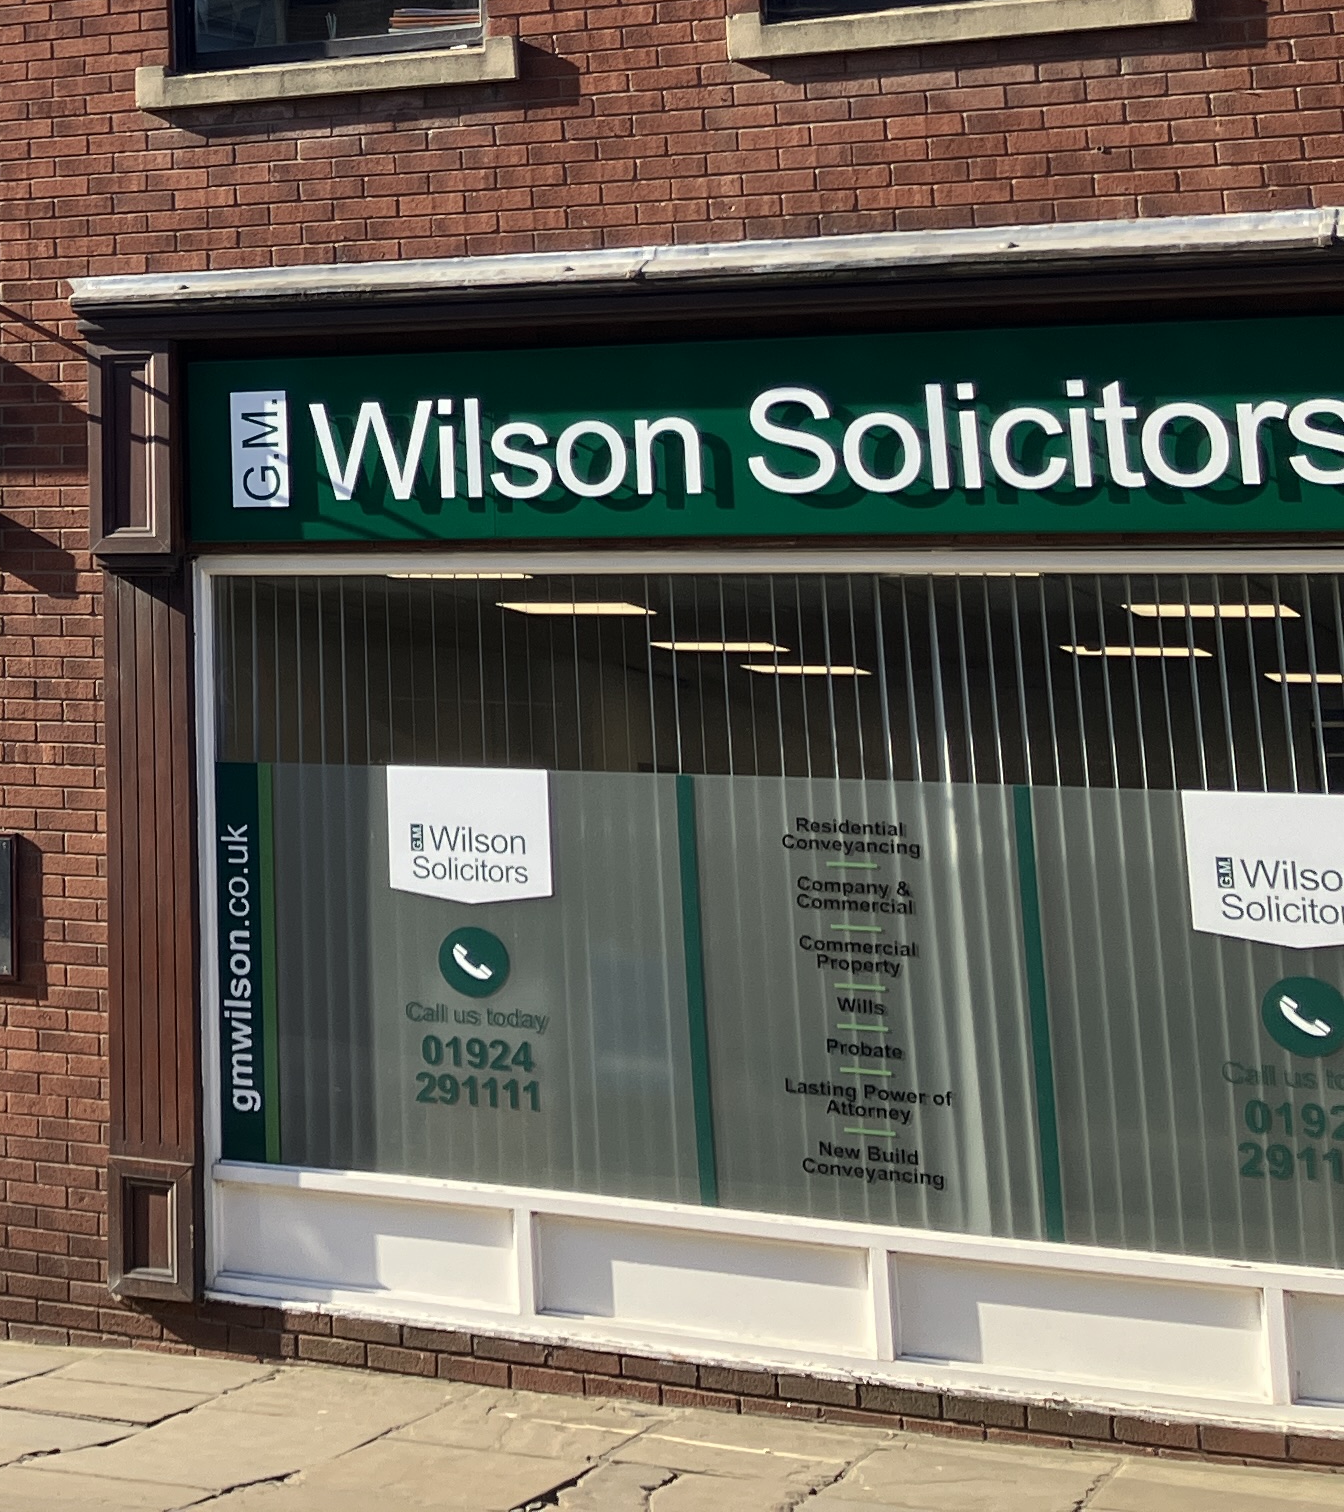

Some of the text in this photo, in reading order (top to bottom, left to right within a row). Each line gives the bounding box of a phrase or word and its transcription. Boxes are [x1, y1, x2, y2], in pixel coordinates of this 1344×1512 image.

[241, 397, 284, 503] G.M.
[310, 380, 1344, 501] Wilson Solicitors
[429, 825, 526, 855] Wilson
[795, 818, 906, 838] Residential
[781, 835, 921, 859] Conveyancing
[413, 855, 529, 884] Solicitors
[1240, 858, 1344, 892] Wilso
[797, 876, 912, 899] Company &
[796, 894, 916, 916] Commercial
[1222, 893, 1344, 925] Solicito
[799, 936, 919, 959] Commercial
[221, 824, 261, 1112] gmwilson.co.uk
[816, 954, 902, 978] Property
[405, 1001, 550, 1035] Call us today
[837, 997, 887, 1017] Wills
[422, 1034, 536, 1073] 01924
[826, 1038, 904, 1061] Probate
[1222, 1061, 1277, 1086] Call
[1283, 1070, 1317, 1089] us
[415, 1072, 541, 1113] 291111
[784, 1078, 954, 1107] Lasting Power of
[826, 1101, 912, 1125] Attorney
[1244, 1099, 1344, 1141] 0192
[818, 1141, 919, 1167] New Build
[1237, 1142, 1344, 1185] 2911
[802, 1158, 945, 1190] Conveyancing
